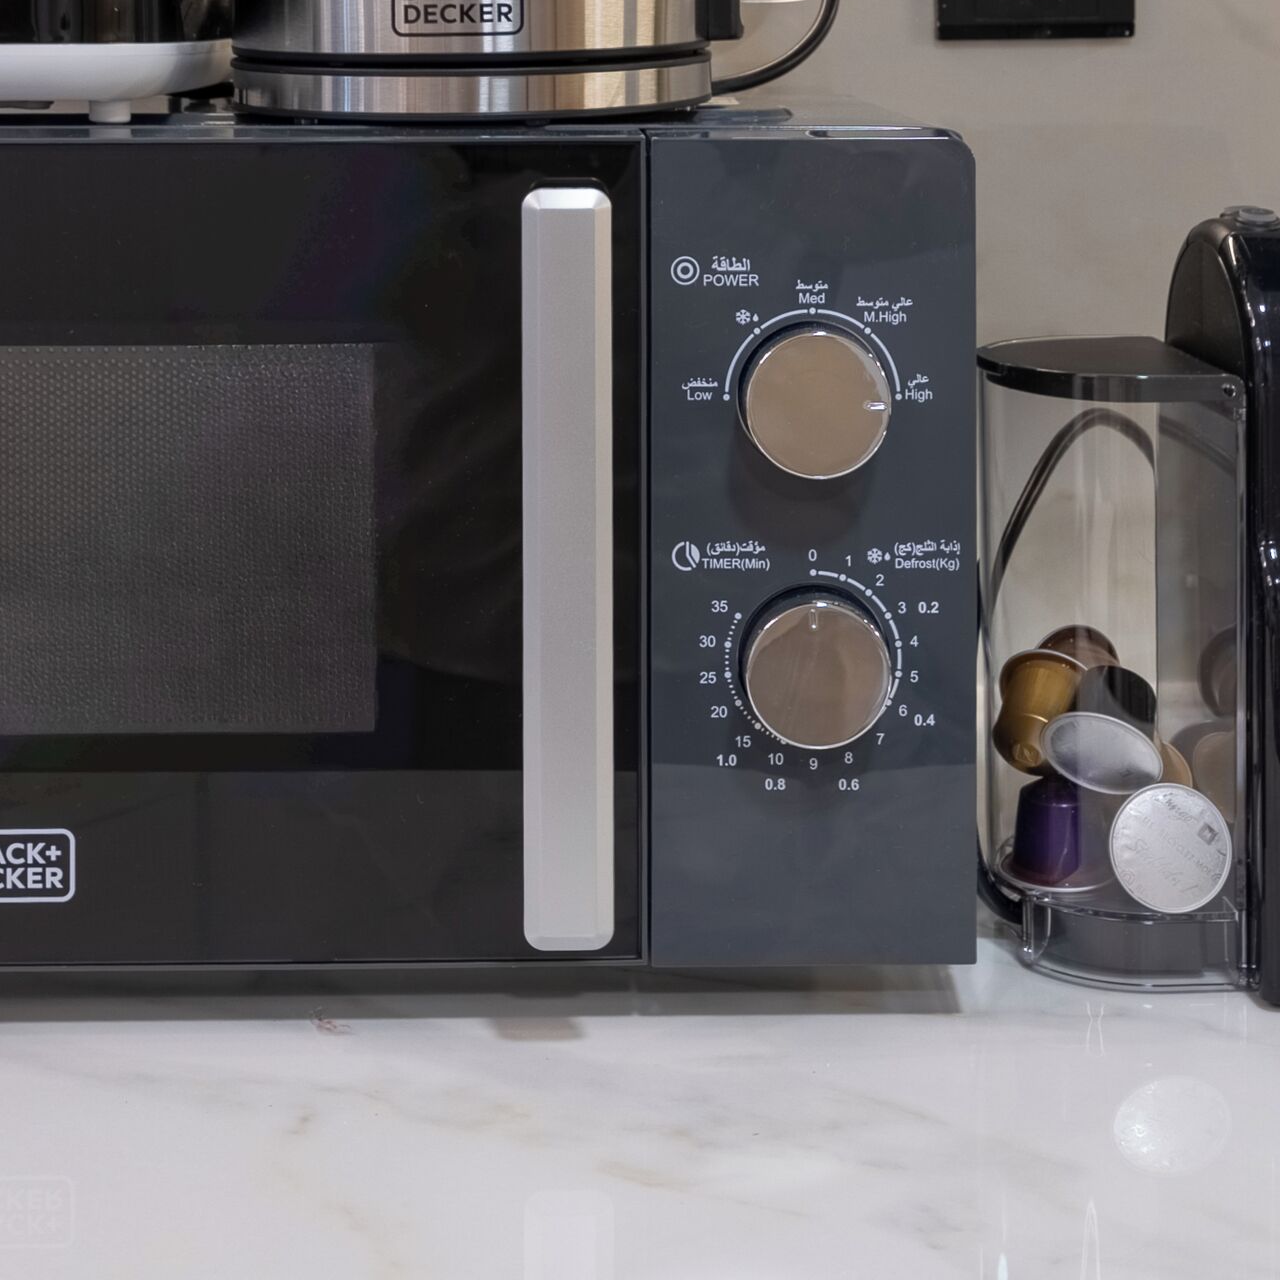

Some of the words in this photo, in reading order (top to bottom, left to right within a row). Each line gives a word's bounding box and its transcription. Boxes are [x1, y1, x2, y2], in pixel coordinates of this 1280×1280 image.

[403, 3, 513, 24] DECKER
[711, 256, 751, 272] الطاقة
[703, 274, 759, 287] POWER
[795, 280, 829, 291] متوسط
[799, 292, 826, 305] Med
[864, 311, 907, 325] M.High
[681, 379, 719, 390] منخفض
[907, 374, 929, 387] عالي
[687, 389, 713, 402] Low
[905, 388, 933, 402] High
[808, 549, 817, 561] 0
[845, 556, 852, 566] 1
[702, 557, 770, 571] TIMER(Min)
[895, 558, 960, 571] Defrost(Kg)
[875, 574, 884, 586] 2
[711, 600, 728, 612] 35
[898, 602, 906, 613] 3
[918, 602, 939, 613] 0.2
[699, 636, 716, 647] 30
[910, 635, 919, 647] 4
[700, 672, 716, 683] 25
[910, 671, 919, 682] 5
[711, 706, 728, 718] 20
[899, 705, 908, 717] 6
[914, 715, 935, 726] 0.4
[735, 736, 751, 748] 15
[876, 733, 885, 745] 7
[717, 755, 737, 766] 1.0
[768, 753, 784, 765] 10
[809, 758, 818, 770] 9
[845, 752, 853, 764] 8
[765, 779, 786, 790] 0.8
[838, 779, 859, 791] 0.6
